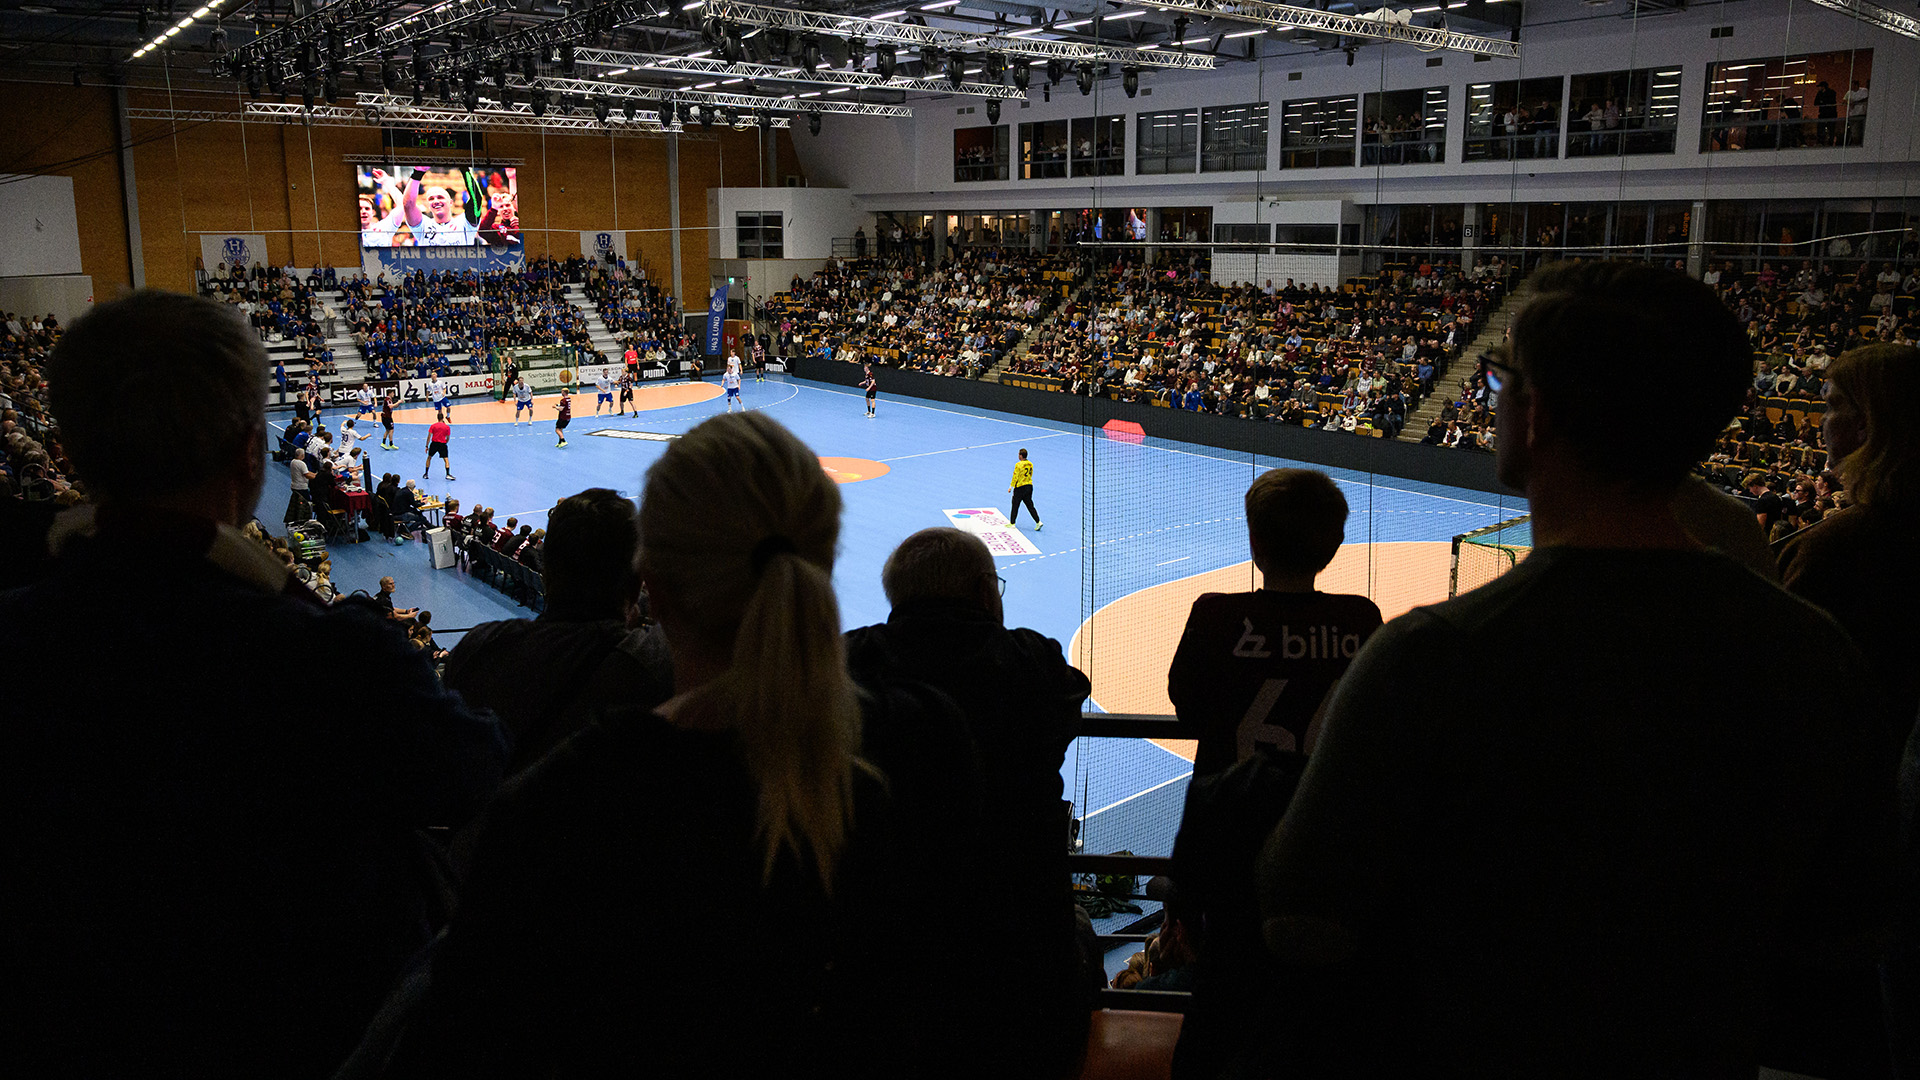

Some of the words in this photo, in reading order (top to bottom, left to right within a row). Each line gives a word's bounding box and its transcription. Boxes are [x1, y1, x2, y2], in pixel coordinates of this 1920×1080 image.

[391, 247, 421, 259] FAN
[425, 246, 488, 259] CORNER
[712, 316, 721, 336] LUND
[711, 337, 719, 351] H43
[643, 368, 666, 379] PUMA
[332, 384, 399, 401] staum
[424, 382, 459, 396] bia
